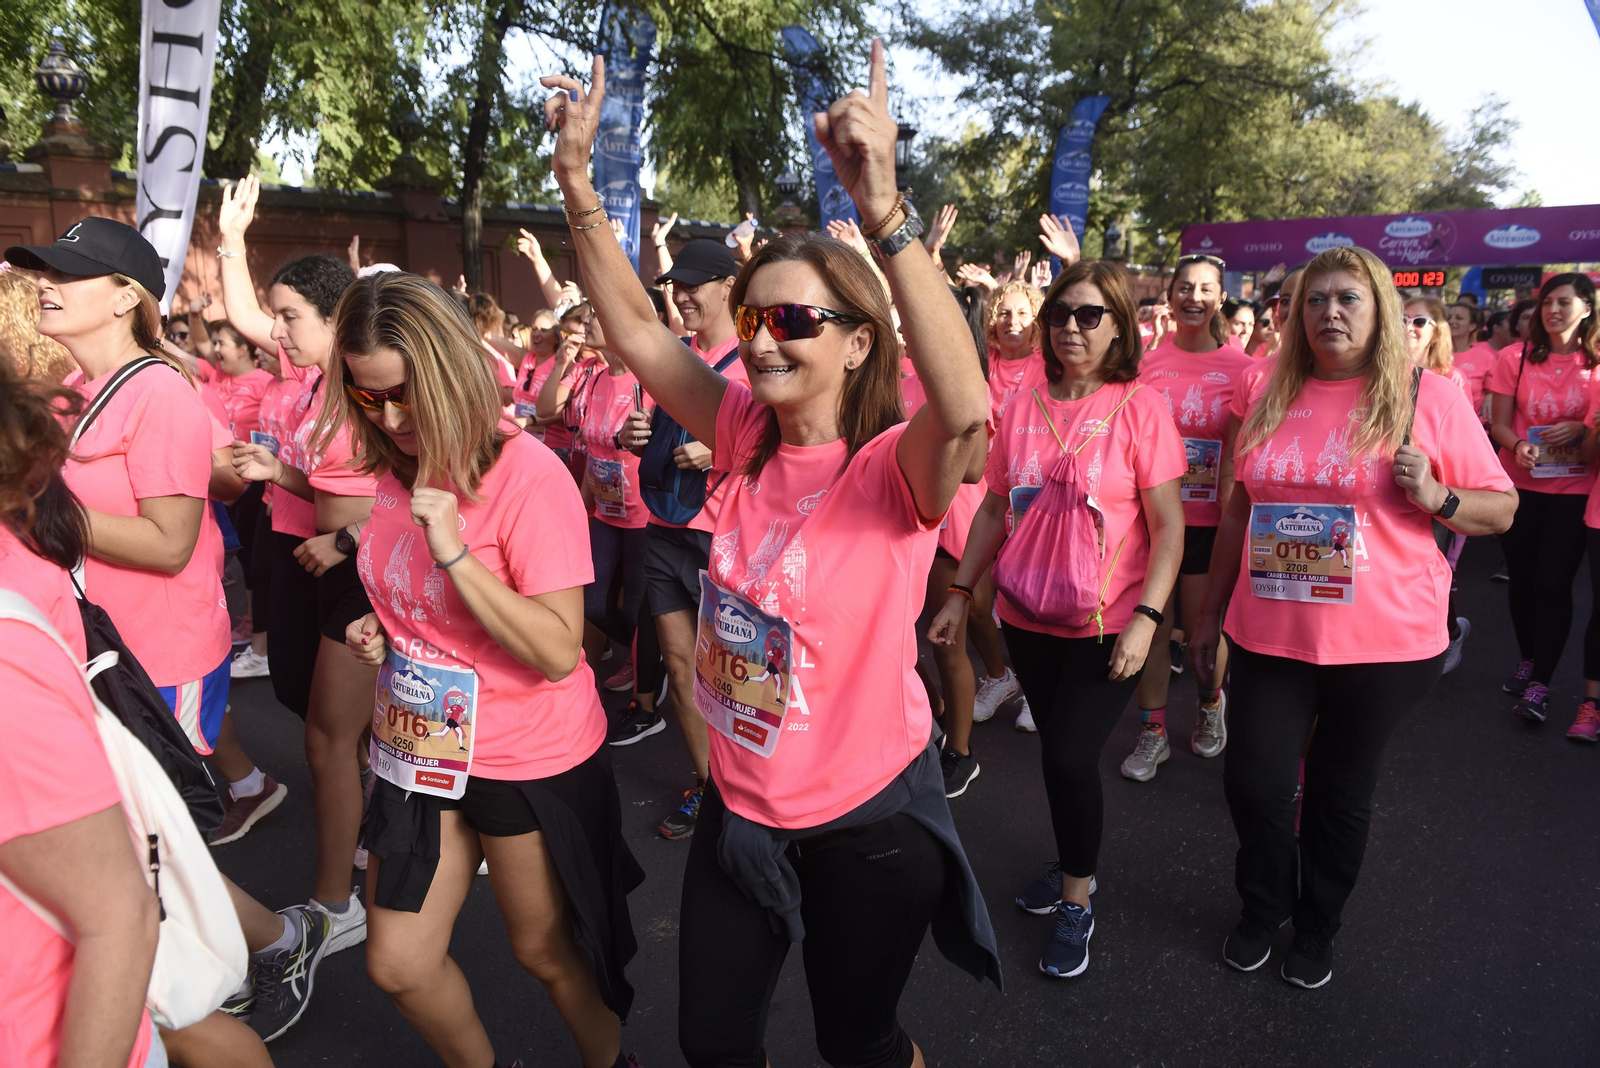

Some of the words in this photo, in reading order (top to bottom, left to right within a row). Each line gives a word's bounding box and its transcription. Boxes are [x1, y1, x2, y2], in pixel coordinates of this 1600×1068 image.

[1244, 243, 1283, 253] OYSHO
[1379, 236, 1420, 249] Carrera
[1401, 246, 1434, 265] Mujer
[1422, 271, 1445, 286] 123
[1287, 408, 1312, 419] SHO
[1016, 425, 1050, 435] OSHO
[377, 492, 398, 510] SHO
[1278, 521, 1321, 532] ASTURIANA
[1276, 541, 1320, 559] 016
[1286, 563, 1308, 572] 2708
[1266, 571, 1290, 579] CARRERA
[1308, 575, 1330, 583] MUJER
[1255, 583, 1286, 594] OYSHO
[708, 641, 749, 681] 016
[392, 676, 431, 701] ASTURIANA
[712, 675, 733, 696] 4249
[723, 697, 731, 708] LA
[732, 701, 757, 717] MUJER
[387, 703, 429, 738] 016
[786, 722, 810, 732] 2022
[743, 726, 764, 740] Santander
[391, 735, 414, 752] 4250
[395, 750, 404, 761] DE
[403, 753, 412, 763] LA
[413, 757, 440, 768] MUJER
[427, 775, 451, 786] Santander
